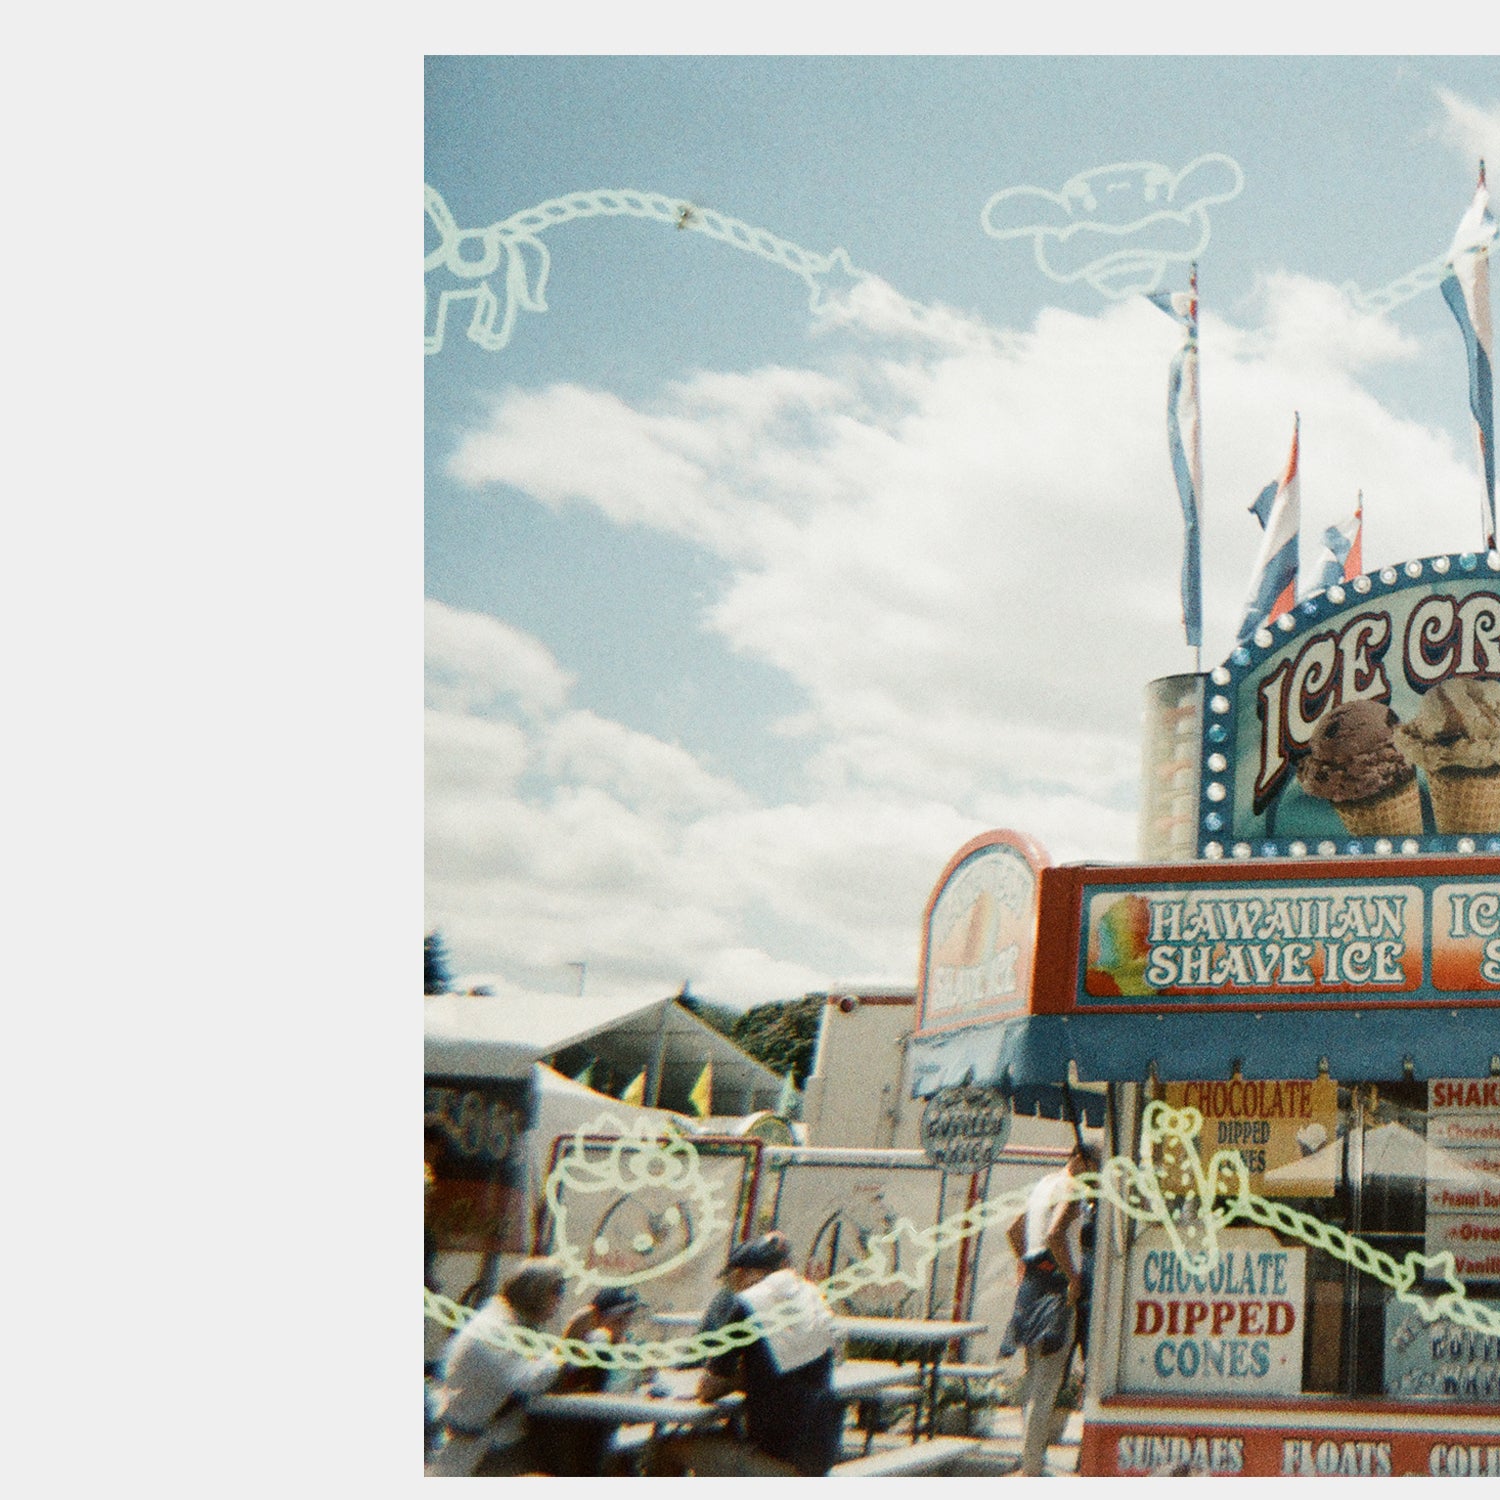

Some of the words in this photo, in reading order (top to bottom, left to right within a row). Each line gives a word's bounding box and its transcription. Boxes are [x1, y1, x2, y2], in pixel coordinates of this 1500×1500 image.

[1255, 612, 1391, 796] ICE
[1149, 896, 1407, 943] HAWAIIAN
[1148, 941, 1315, 986] SHAVE
[1321, 940, 1406, 985] ICE
[1184, 1080, 1313, 1118] CHOCOLATE
[1217, 1120, 1270, 1145] DIPPED
[1133, 1301, 1296, 1337] DIPPED
[1153, 1339, 1271, 1379] CONES
[1116, 1434, 1244, 1472] SUNDAES
[1281, 1437, 1392, 1476] FLOATS
